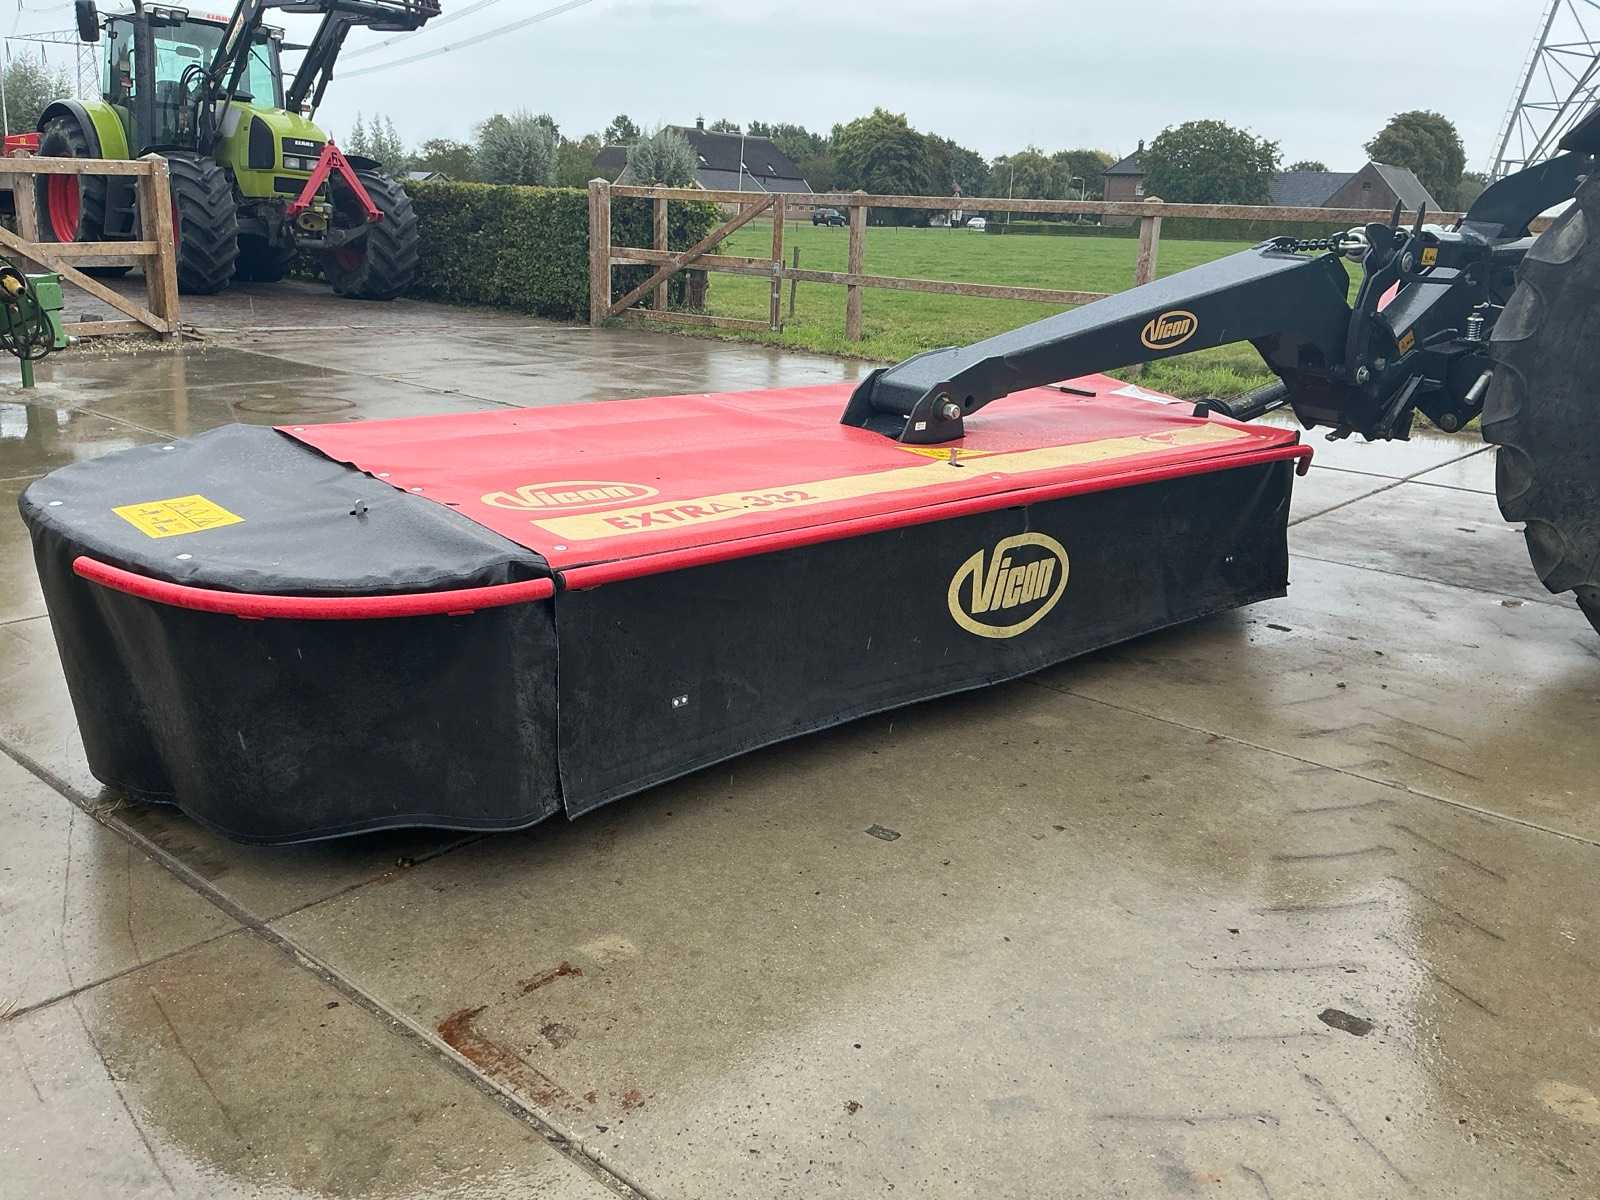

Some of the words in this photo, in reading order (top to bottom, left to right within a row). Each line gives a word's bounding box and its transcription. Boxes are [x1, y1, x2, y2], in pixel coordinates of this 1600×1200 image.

[1147, 314, 1193, 343] Vicon
[496, 484, 640, 509] Vicon
[603, 502, 740, 530] EXTRA
[741, 490, 817, 508] 332
[966, 538, 1060, 618] Vicon
